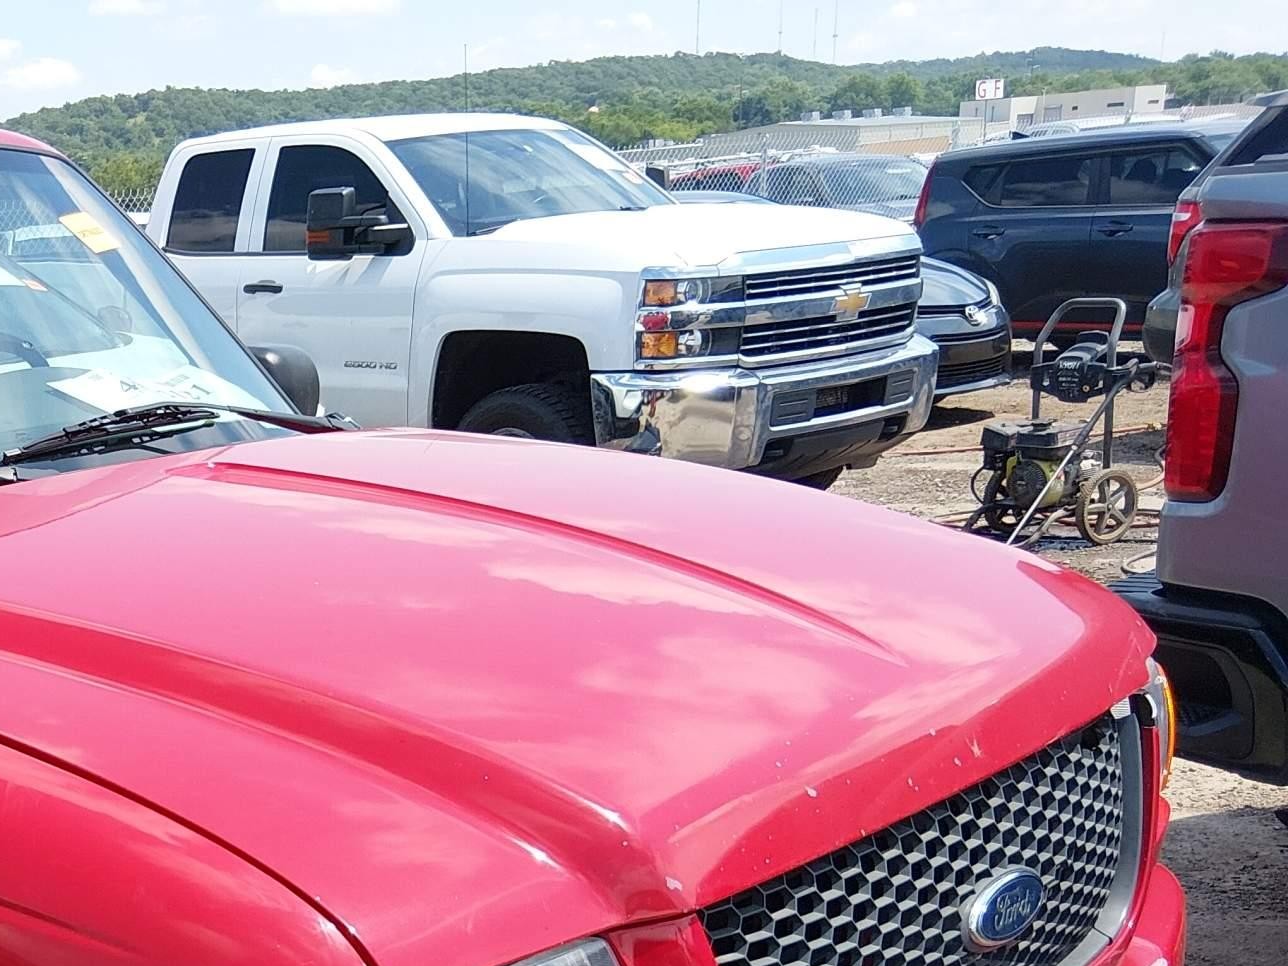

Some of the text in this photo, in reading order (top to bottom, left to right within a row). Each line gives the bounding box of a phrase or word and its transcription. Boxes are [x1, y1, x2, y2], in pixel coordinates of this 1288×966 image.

[977, 79, 1001, 99] G F
[993, 885, 1032, 932] Ford
